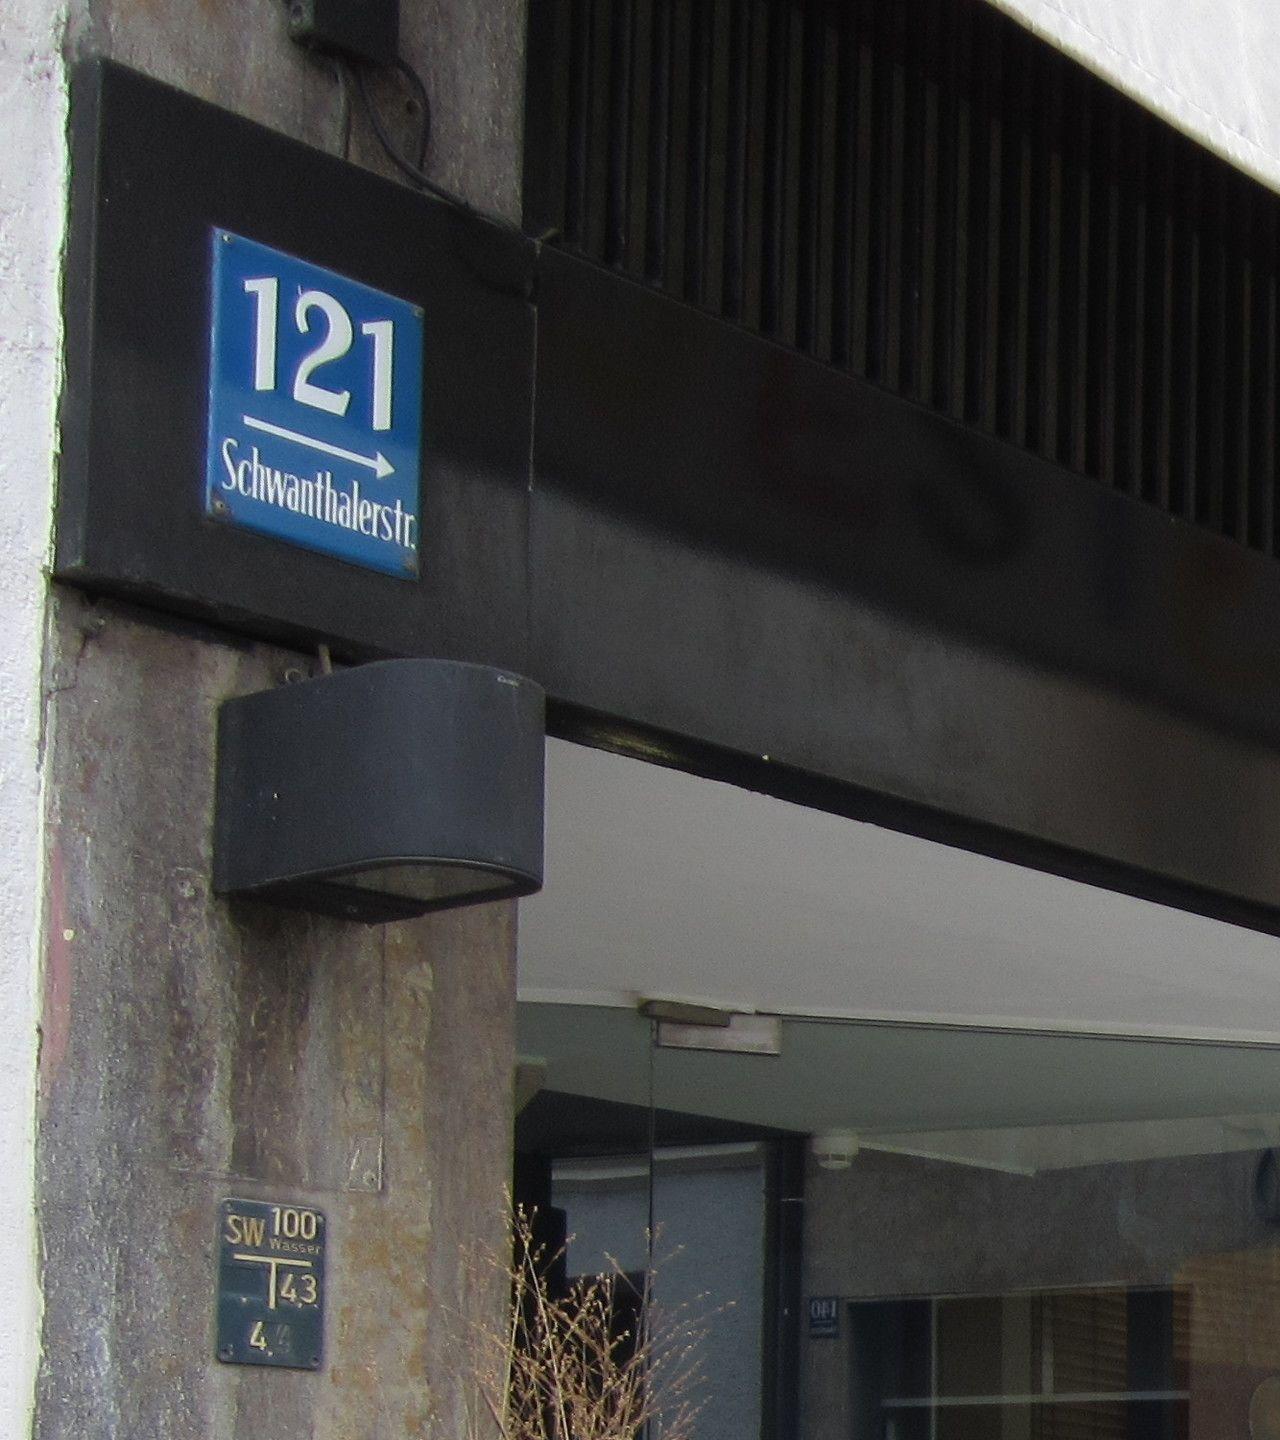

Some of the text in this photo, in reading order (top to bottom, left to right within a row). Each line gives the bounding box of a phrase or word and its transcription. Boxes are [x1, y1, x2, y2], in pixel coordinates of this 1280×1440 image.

[244, 276, 394, 431] 121
[222, 437, 417, 551] Schwanthalerstr.
[227, 1207, 316, 1247] SW 100
[269, 1238, 321, 1255] Wasser
